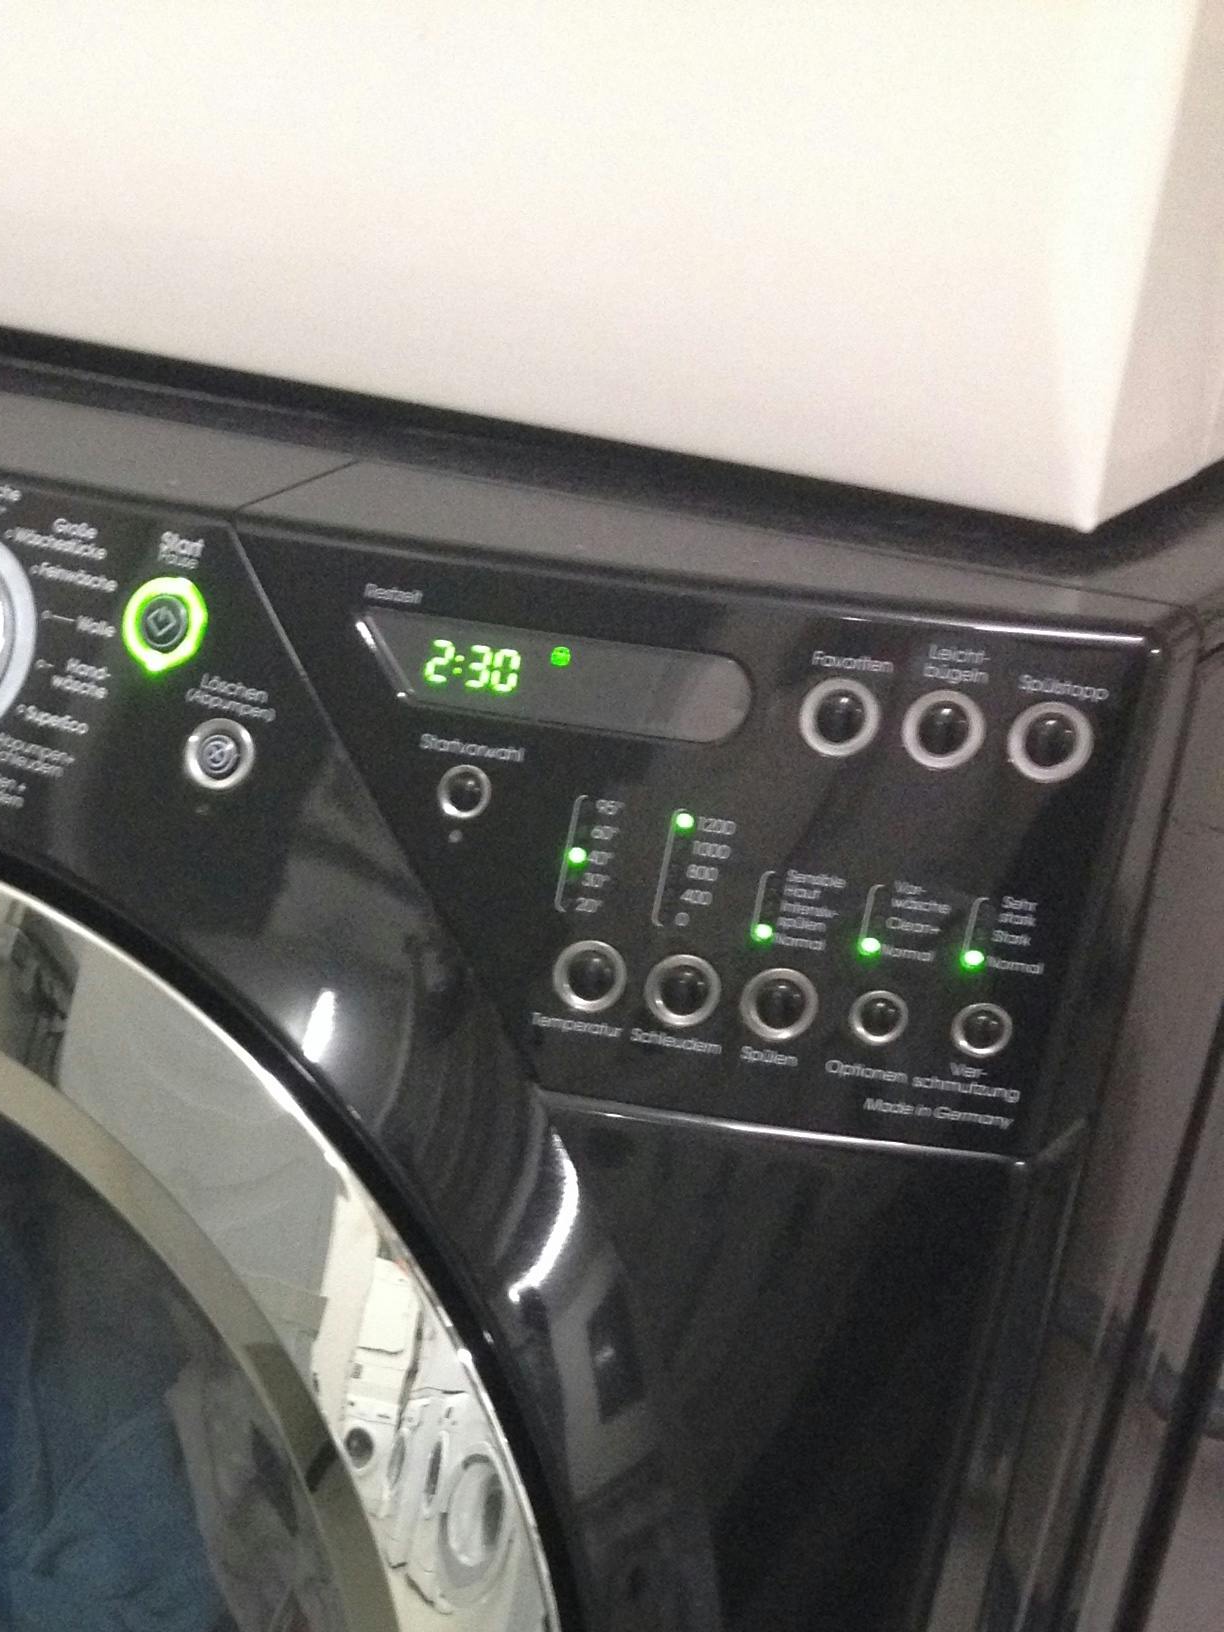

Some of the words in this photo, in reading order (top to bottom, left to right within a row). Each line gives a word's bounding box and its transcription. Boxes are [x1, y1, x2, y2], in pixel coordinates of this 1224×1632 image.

[425, 639, 522, 693] 2:30
[812, 650, 894, 673] Favoriten
[696, 816, 737, 835] 1200
[532, 1012, 624, 1038] Temperatur
[630, 1027, 722, 1055] Schleudern
[825, 1059, 908, 1084] Optionen
[912, 1076, 1021, 1104] schmutzung
[863, 1097, 913, 1116] Made
[915, 1103, 932, 1117] in
[932, 1105, 1015, 1130] Germany
